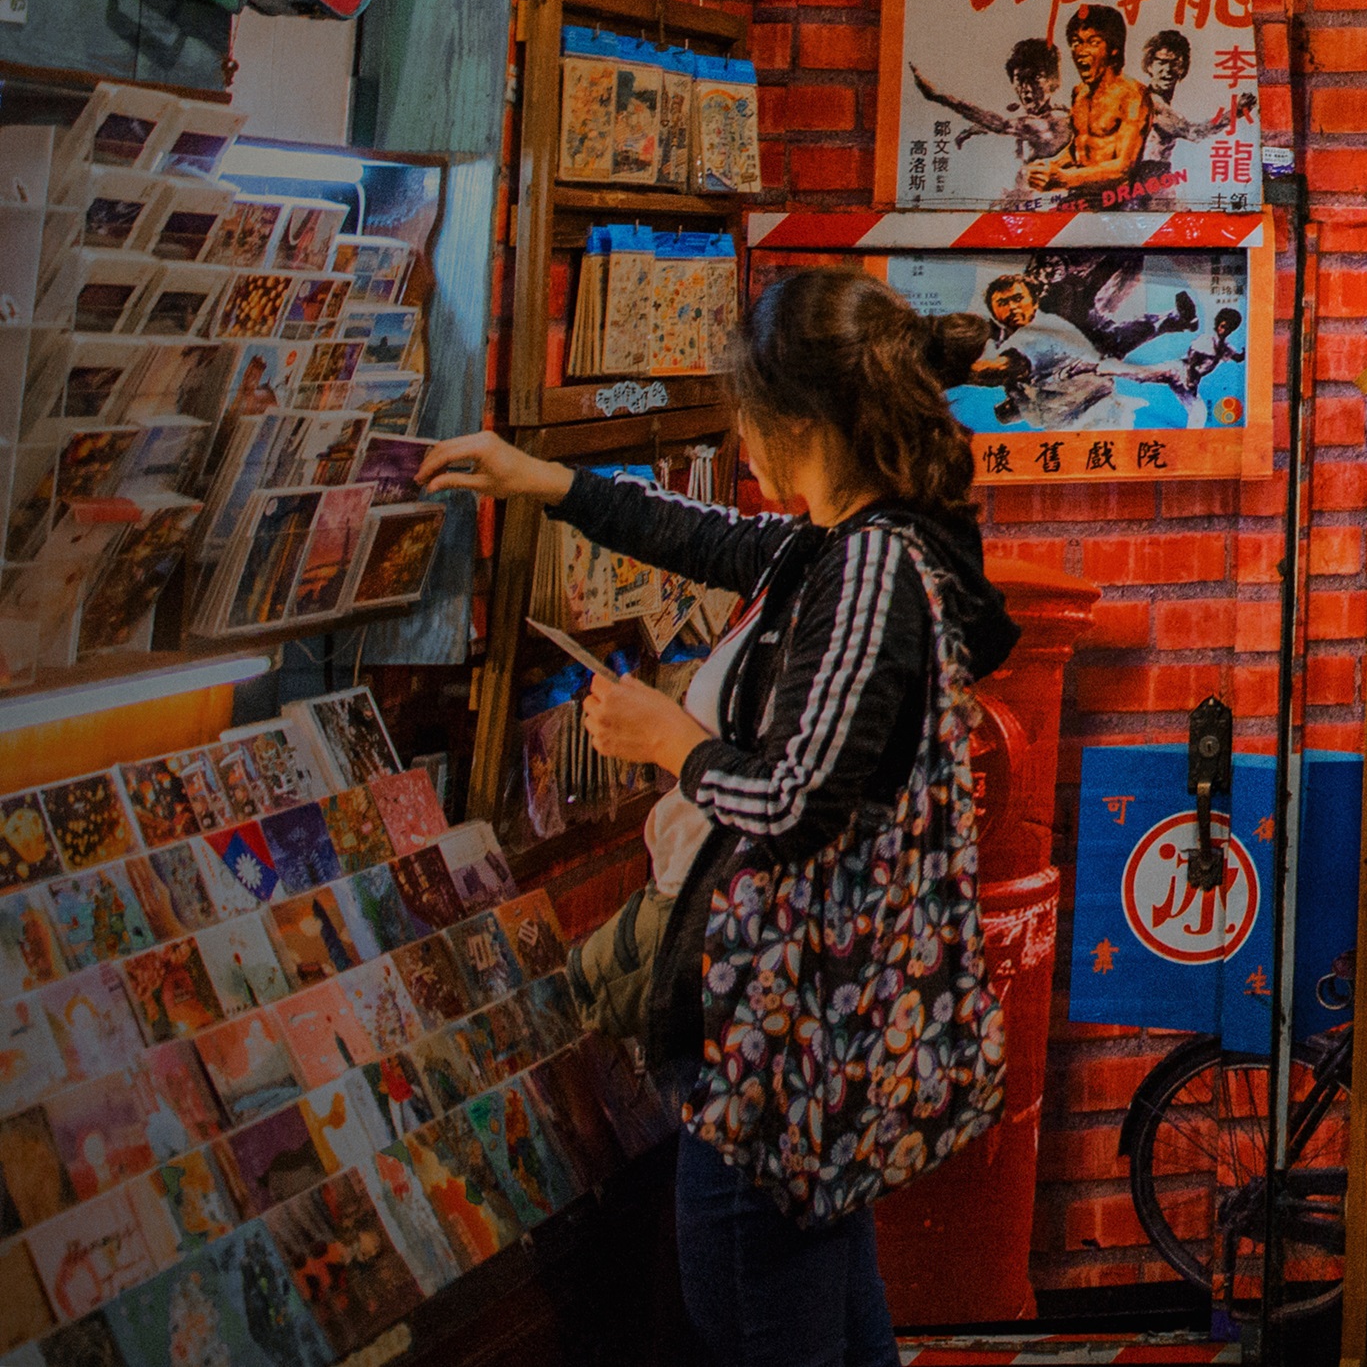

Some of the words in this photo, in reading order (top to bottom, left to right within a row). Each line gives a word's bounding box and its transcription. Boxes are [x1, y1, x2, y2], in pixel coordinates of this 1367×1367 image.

[1208, 45, 1258, 185] 李小龍
[1101, 168, 1189, 207] DRAGON
[981, 440, 1169, 474] 懷舊戲院
